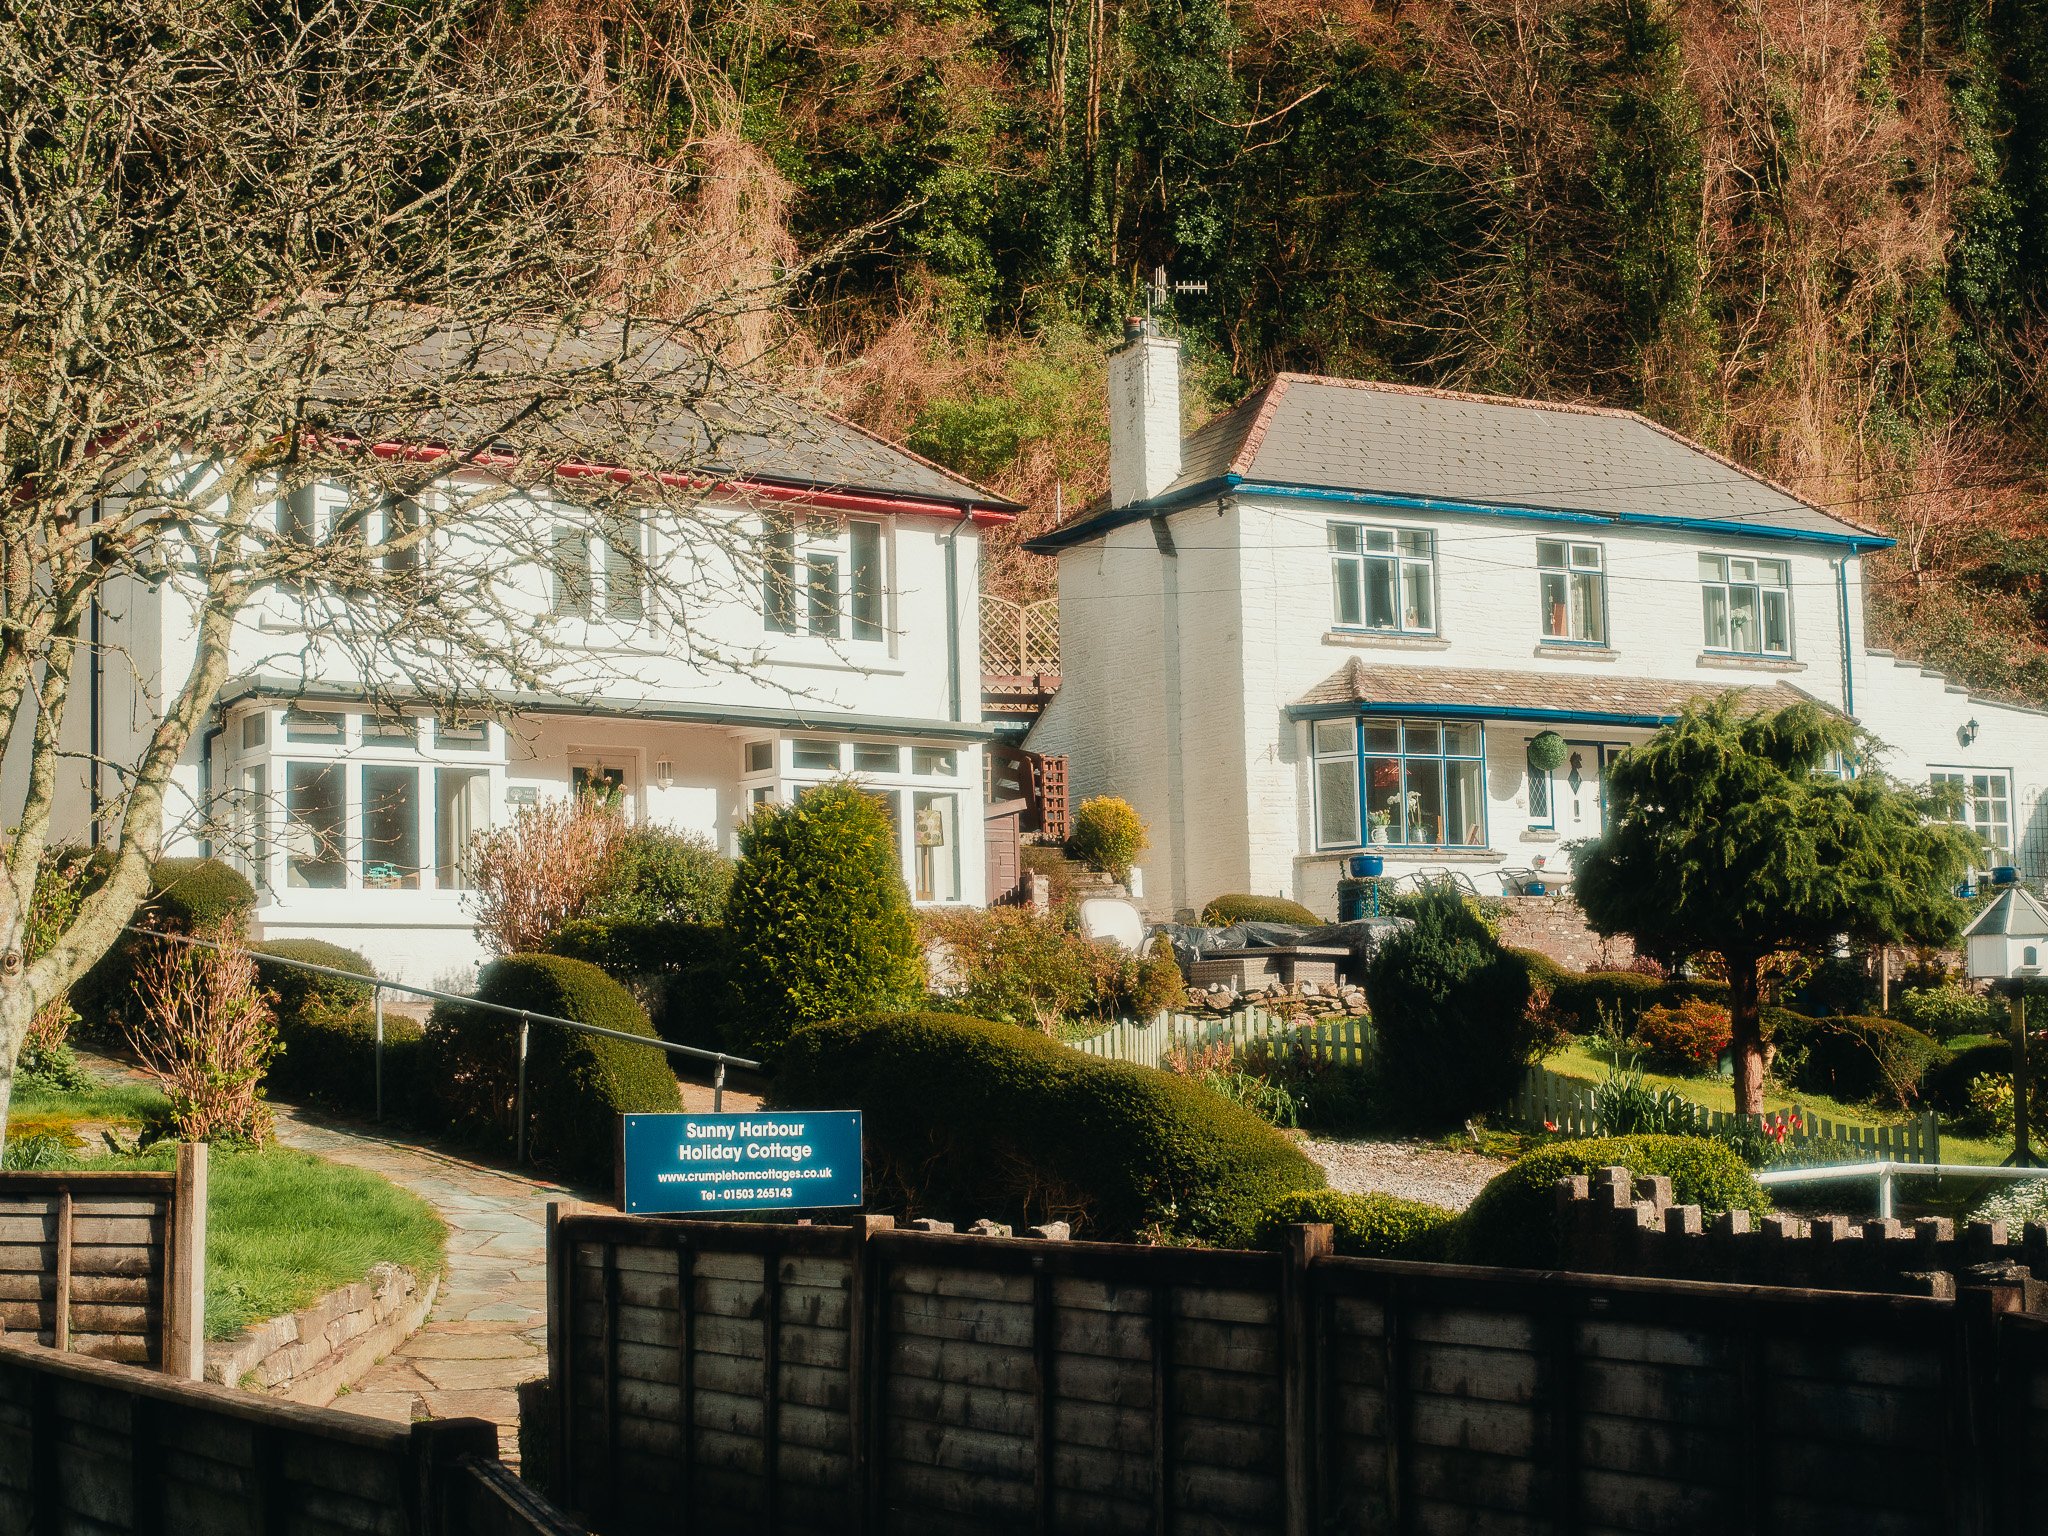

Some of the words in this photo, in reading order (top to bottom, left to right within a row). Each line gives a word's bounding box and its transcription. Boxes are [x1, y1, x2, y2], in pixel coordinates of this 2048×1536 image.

[687, 1122, 735, 1140] Sunny
[740, 1122, 804, 1137] Harbour
[679, 1144, 742, 1162] Holiday
[747, 1143, 812, 1161] Cottage
[658, 1168, 832, 1183] www.crumplehorncottages.co.uk
[701, 1190, 715, 1200] Tel
[724, 1189, 754, 1200] 01503
[757, 1188, 792, 1199] 265143
